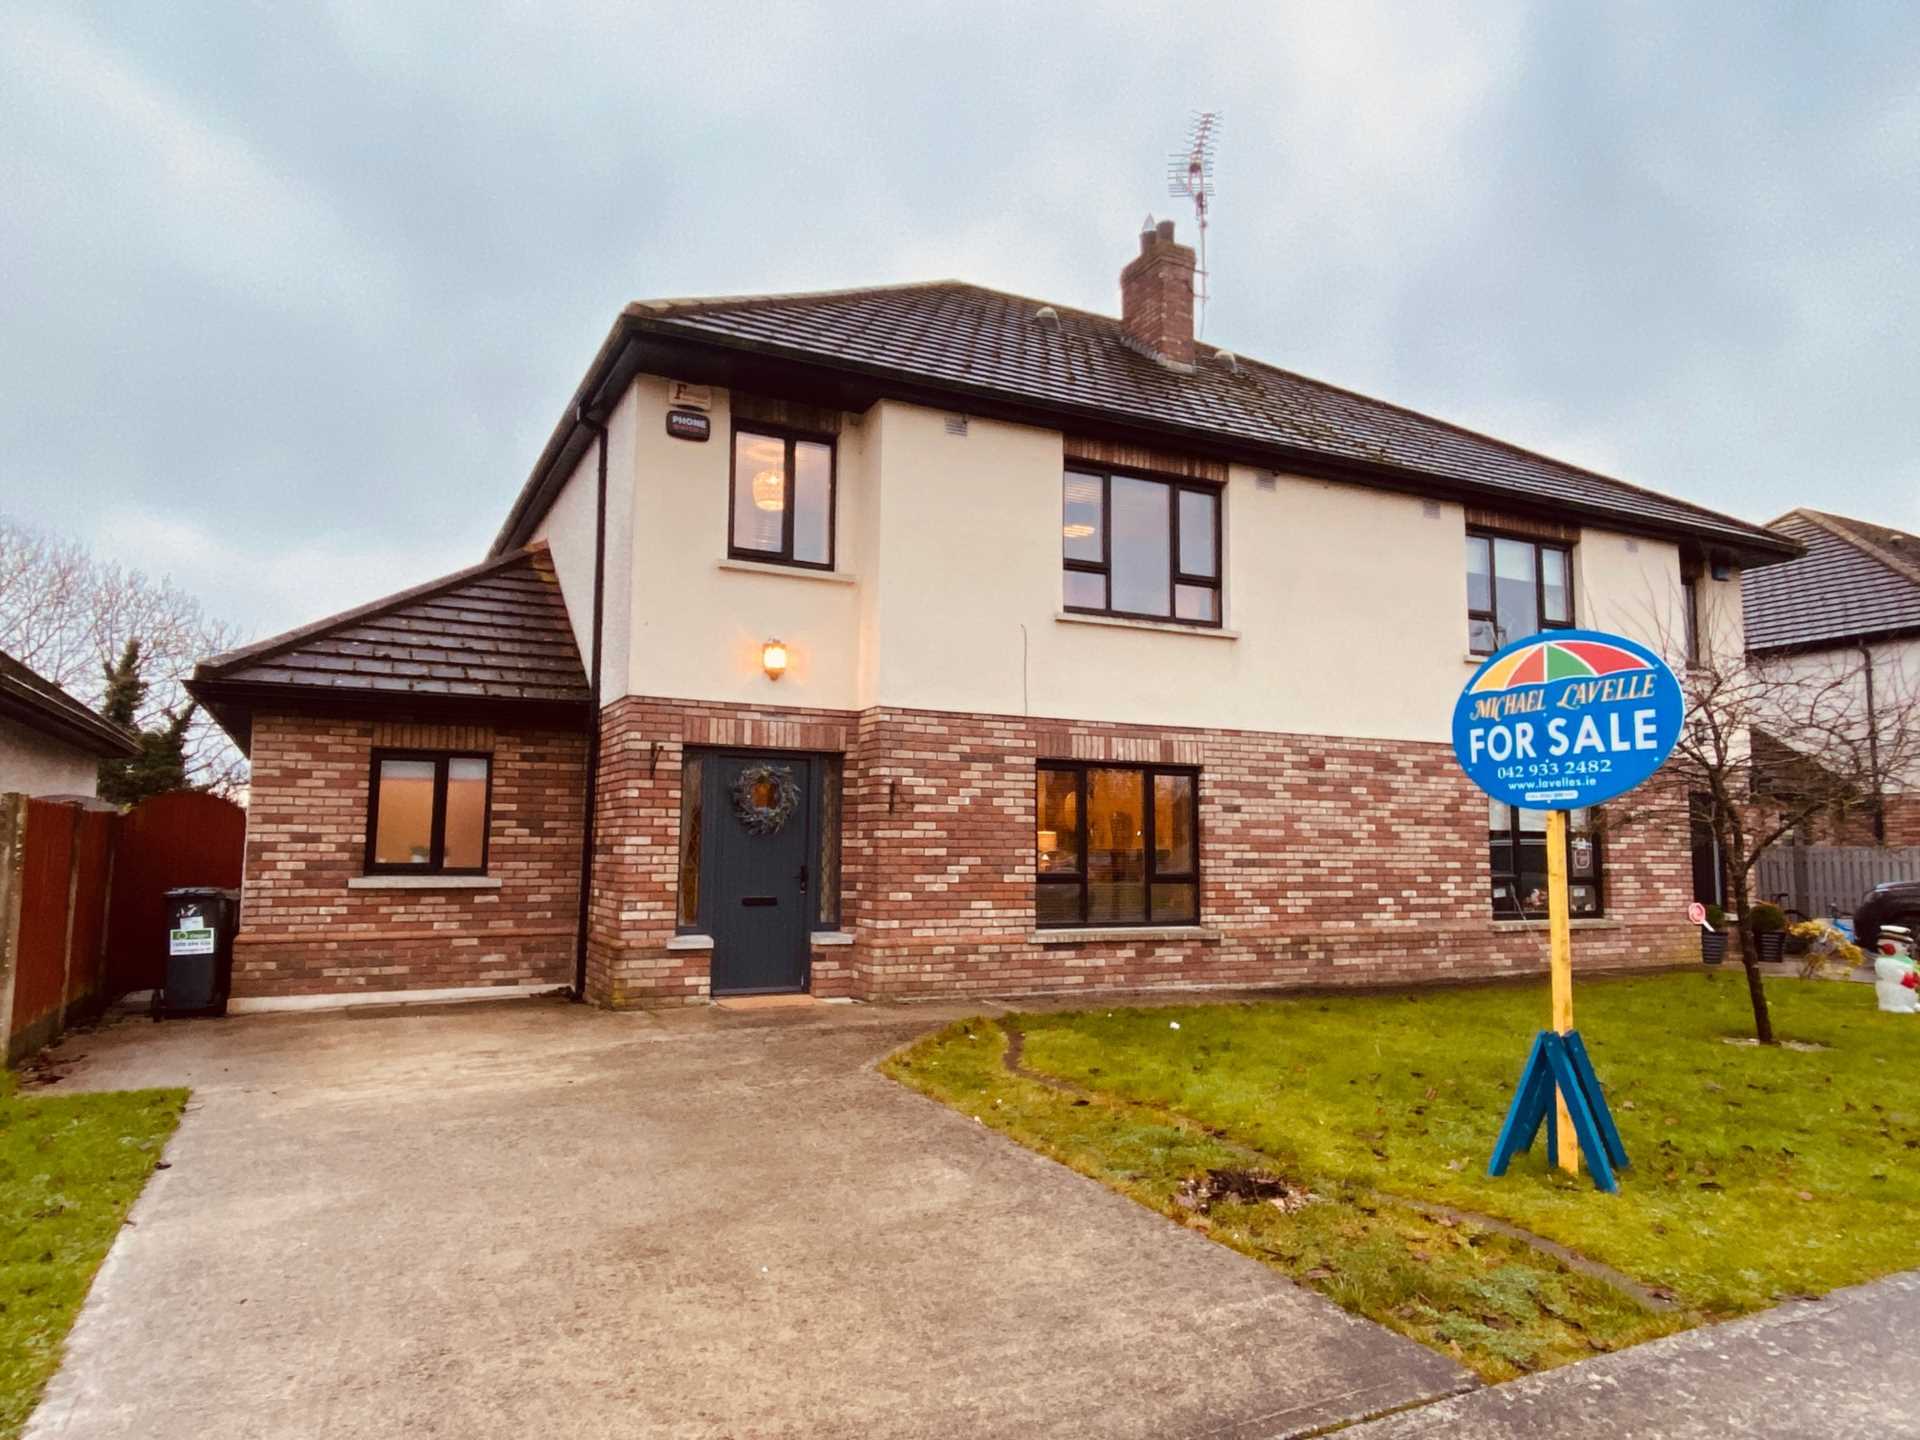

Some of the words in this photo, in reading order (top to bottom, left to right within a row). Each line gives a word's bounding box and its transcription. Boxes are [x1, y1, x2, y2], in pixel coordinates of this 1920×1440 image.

[1471, 689, 1545, 720] MICHAEL
[1556, 674, 1657, 709] LAVELLE
[1469, 722, 1537, 764] FOR
[1548, 709, 1657, 756] SALE
[1497, 765, 1524, 780] 042
[1528, 762, 1559, 777] 933
[1564, 759, 1612, 774] 2482
[1507, 775, 1597, 790] www.lavelles.ie
